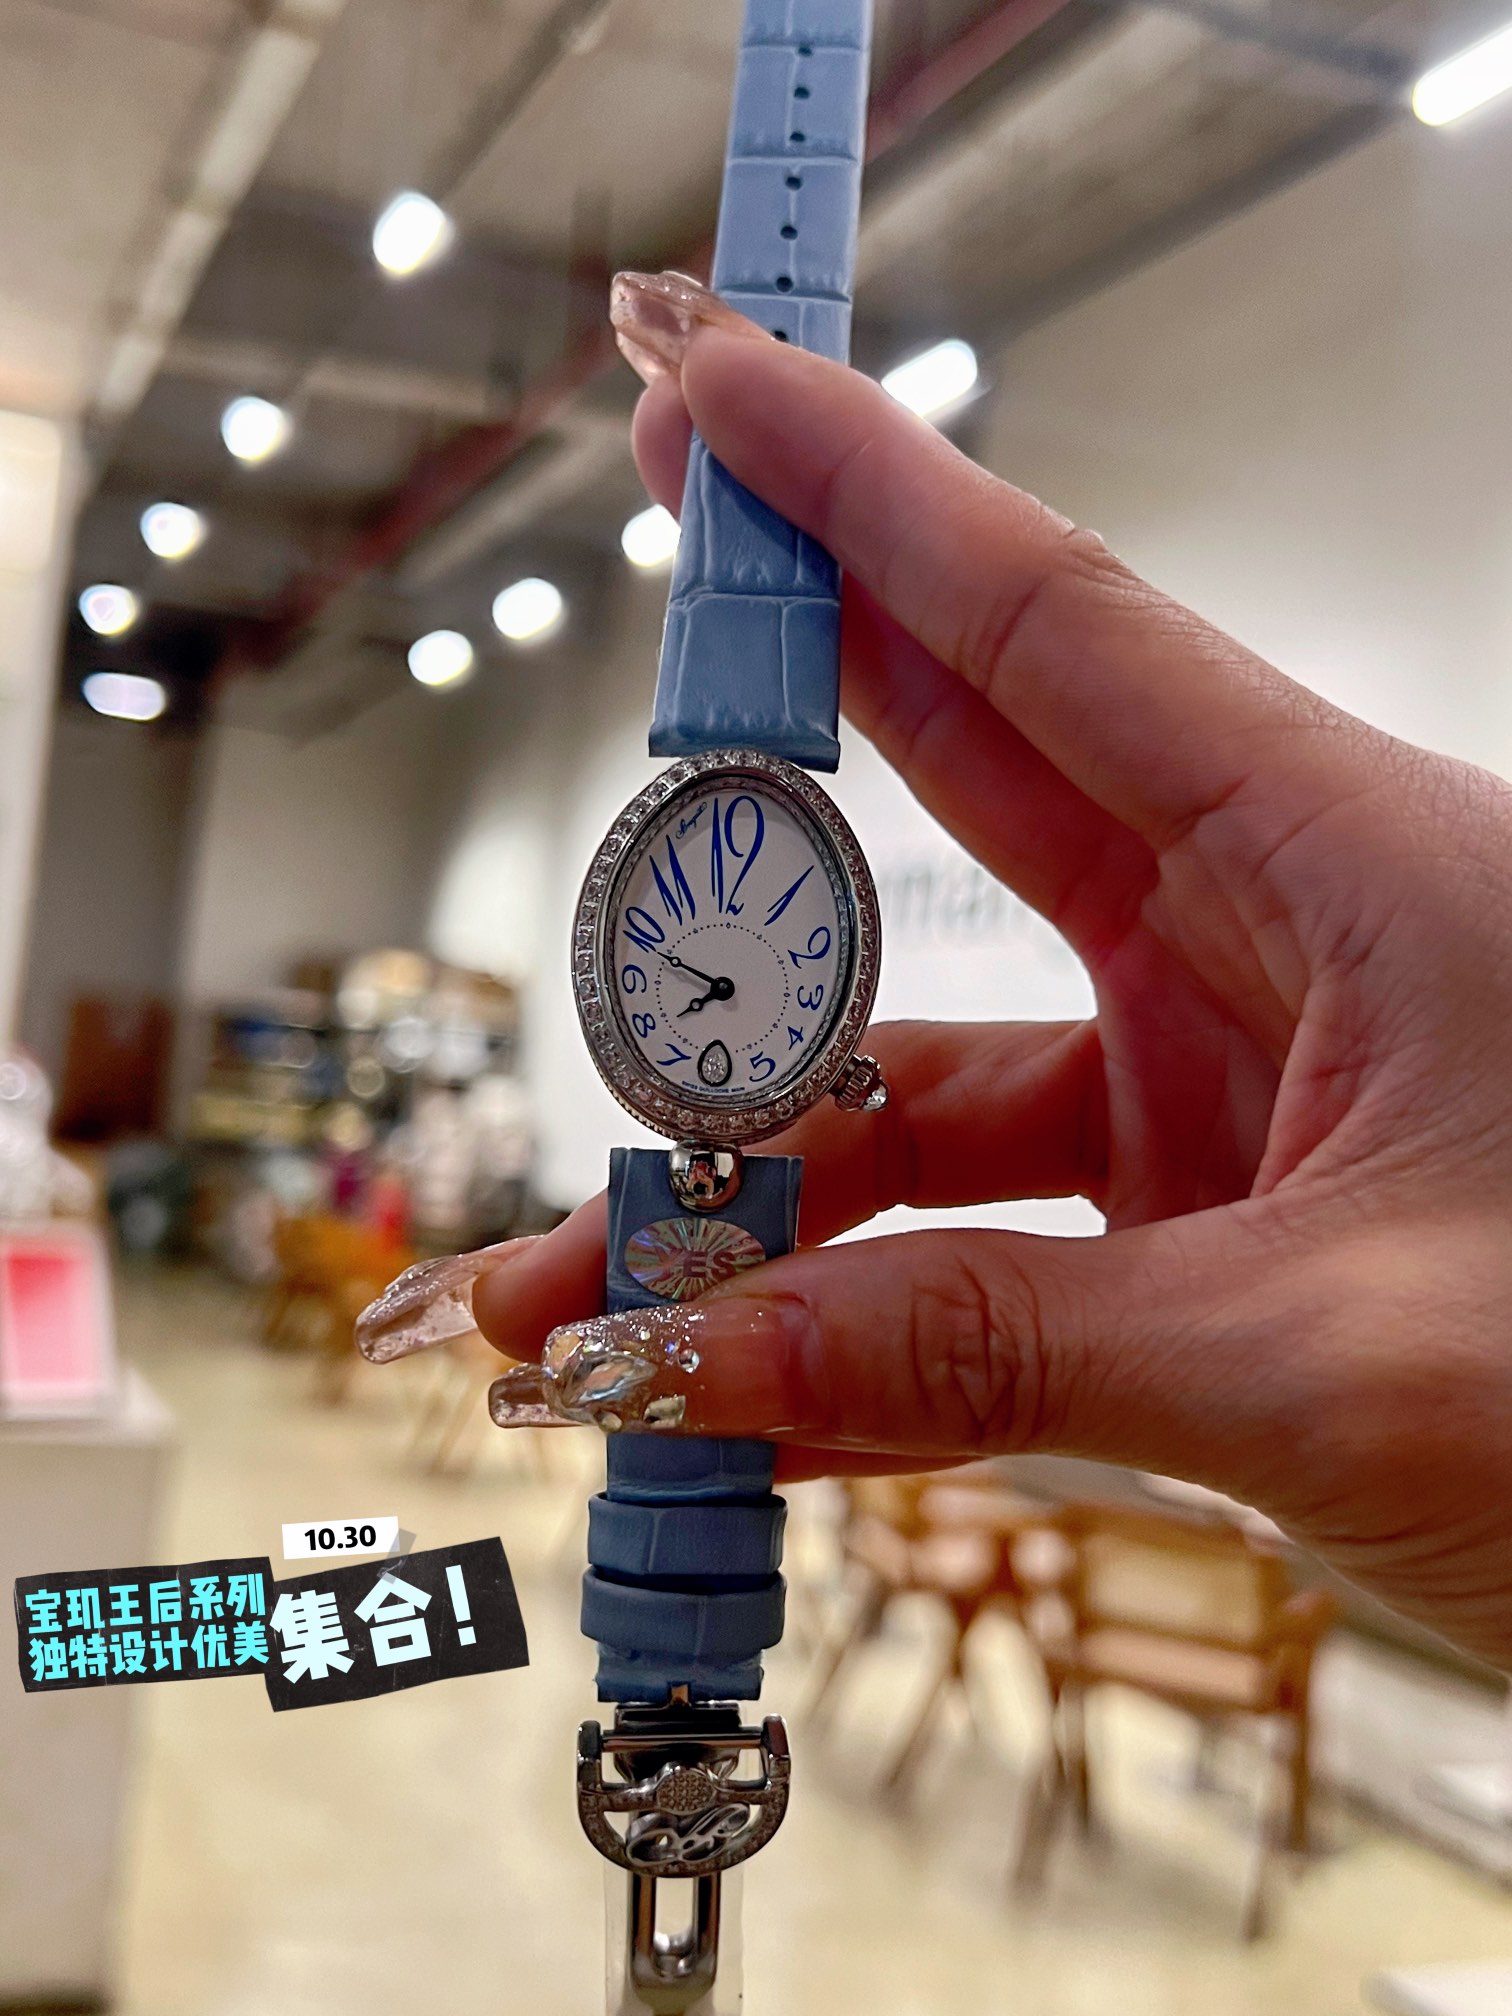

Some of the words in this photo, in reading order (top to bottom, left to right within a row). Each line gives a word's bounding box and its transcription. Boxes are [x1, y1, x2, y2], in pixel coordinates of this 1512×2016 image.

[711, 795, 765, 916] 12
[650, 834, 696, 926] 11
[764, 865, 814, 926] 1
[622, 906, 665, 953] 10
[787, 926, 831, 968] 2
[621, 964, 647, 994] 9
[797, 984, 824, 1011] 3
[632, 1012, 656, 1038] 8
[787, 1025, 804, 1050] 4
[656, 1043, 691, 1067] 7
[749, 1051, 776, 1082] 5
